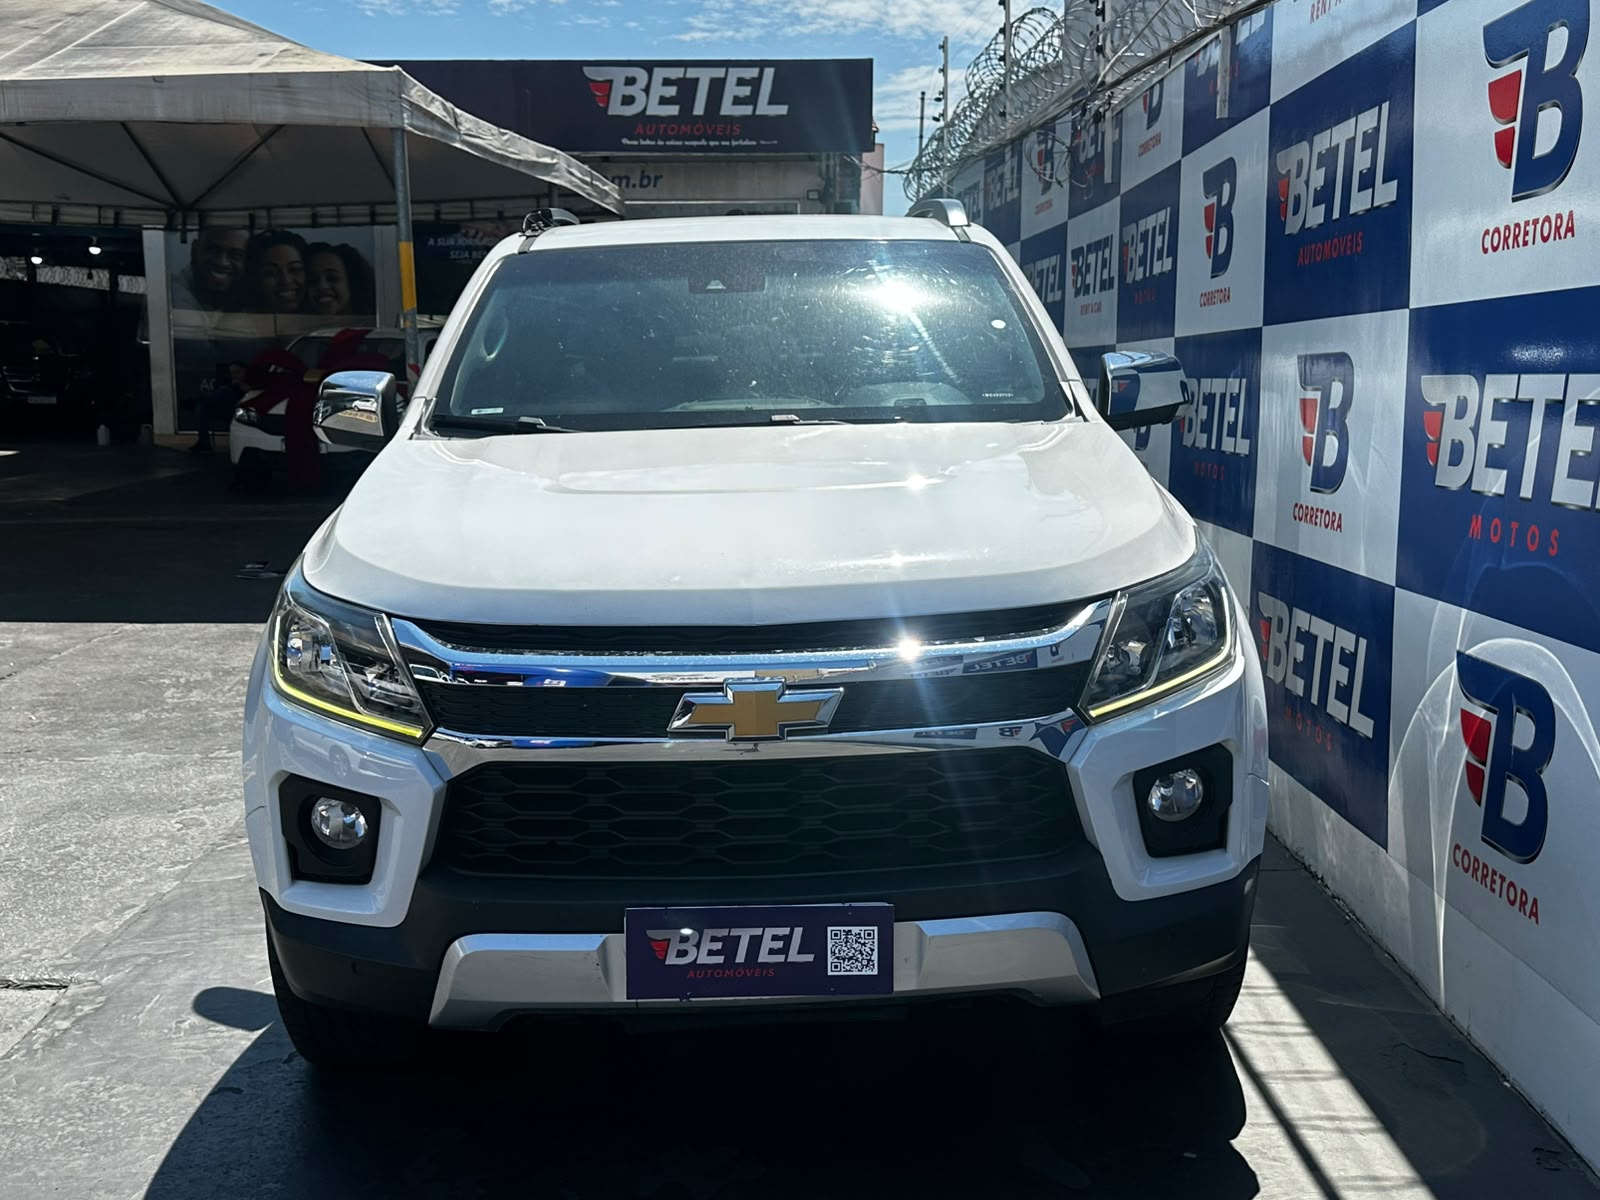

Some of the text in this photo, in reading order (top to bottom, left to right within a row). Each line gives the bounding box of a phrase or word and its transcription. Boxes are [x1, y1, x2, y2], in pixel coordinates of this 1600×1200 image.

[583, 66, 789, 117] BETEL
[635, 121, 742, 136] AUTOMÓVEIS
[610, 170, 664, 189] m.br
[1276, 100, 1398, 236] BETEL
[1122, 207, 1173, 284] BETEL
[1297, 231, 1364, 266] AUTOMÓVEIS
[1481, 210, 1575, 255] CORRETORA
[1071, 233, 1115, 298] BETEL
[1199, 286, 1231, 308] CORRETORA
[1175, 377, 1250, 457] BETEL
[1421, 373, 1600, 513] BETE
[1292, 502, 1343, 533] CORRETORA
[1469, 514, 1560, 556] MOTOS
[1258, 591, 1376, 741] BETEL
[1285, 702, 1333, 752] MOTOS
[1452, 842, 1540, 925] CORRETORA
[646, 927, 815, 966] BETEL
[687, 967, 775, 979] AUTOMÓVEIS
